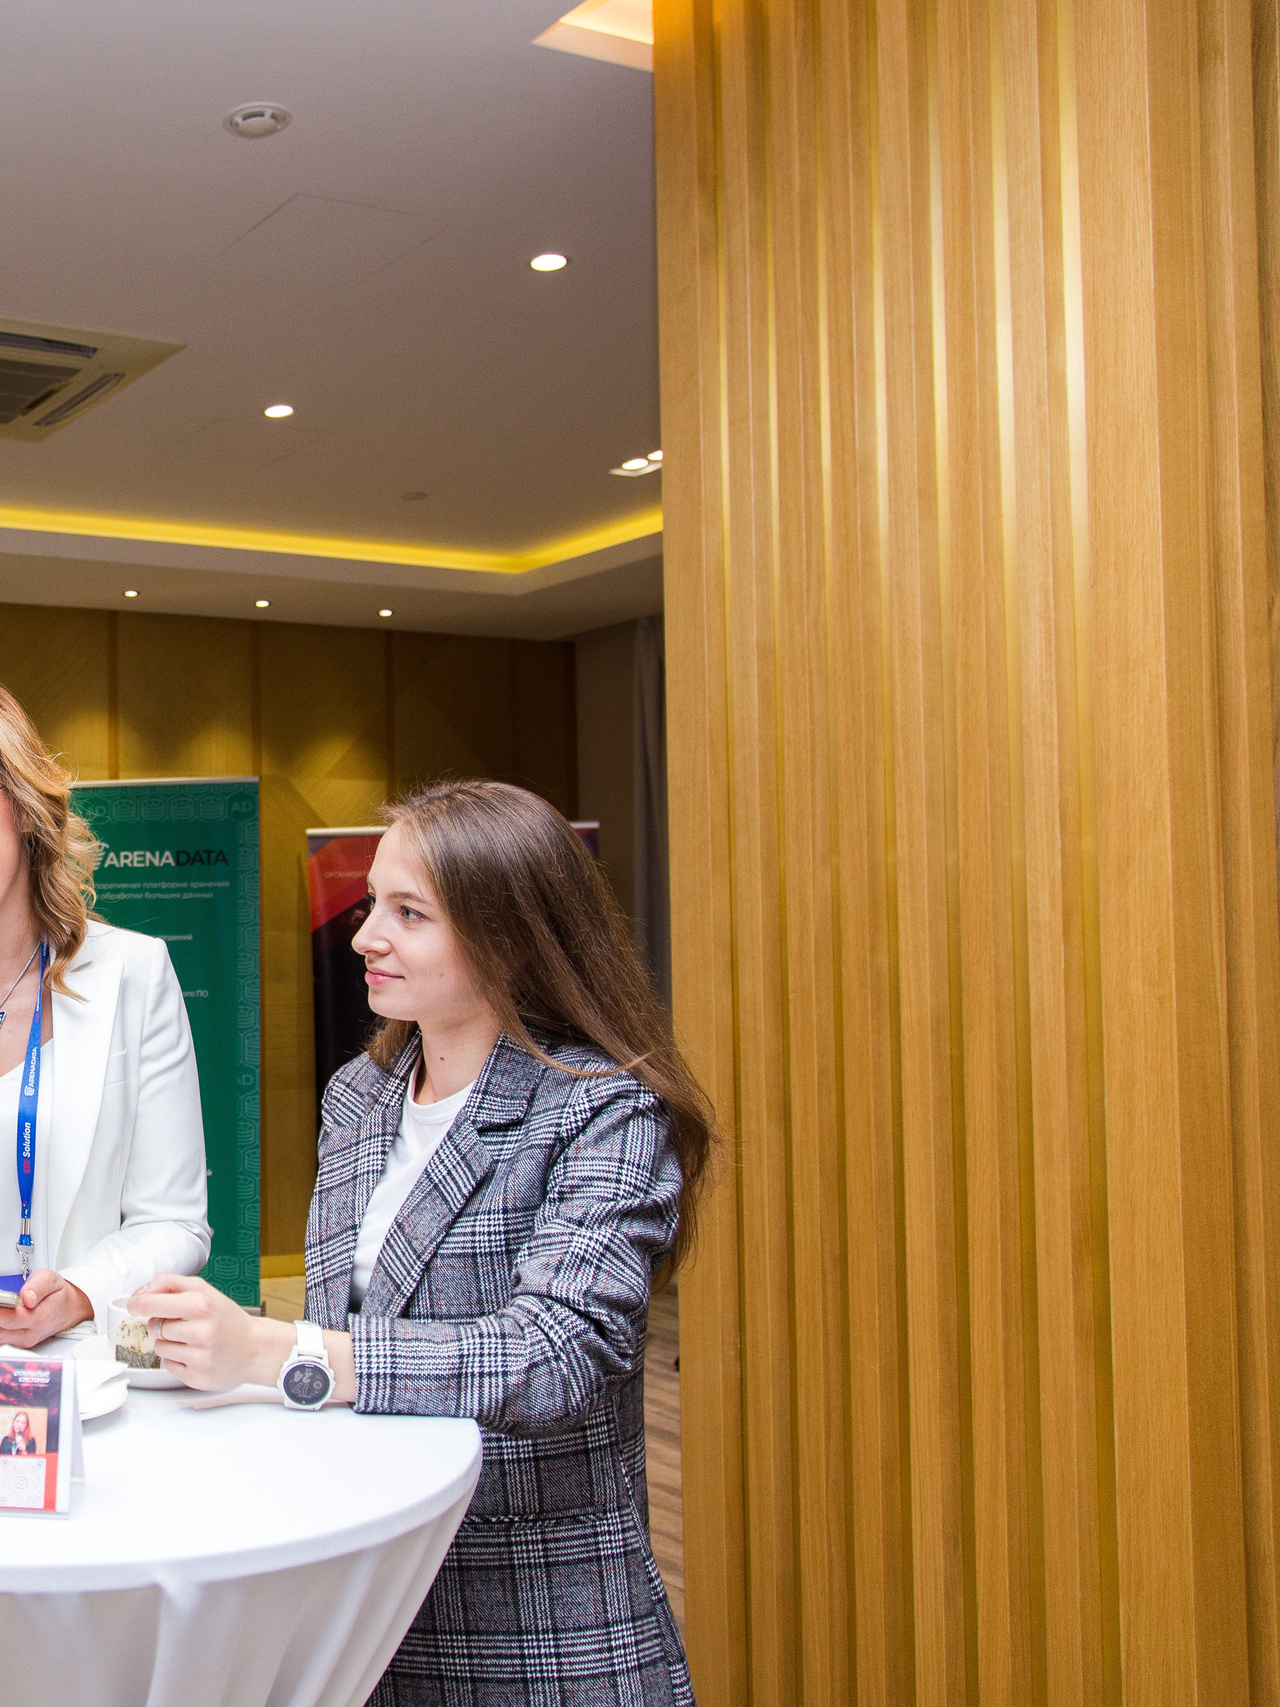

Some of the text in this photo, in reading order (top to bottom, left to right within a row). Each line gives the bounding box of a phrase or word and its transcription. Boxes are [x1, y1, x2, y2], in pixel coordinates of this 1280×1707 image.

[104, 850, 229, 868] ARENADATA
[28, 1047, 38, 1088] ARENADATA
[23, 1122, 32, 1174] SDI Solution
